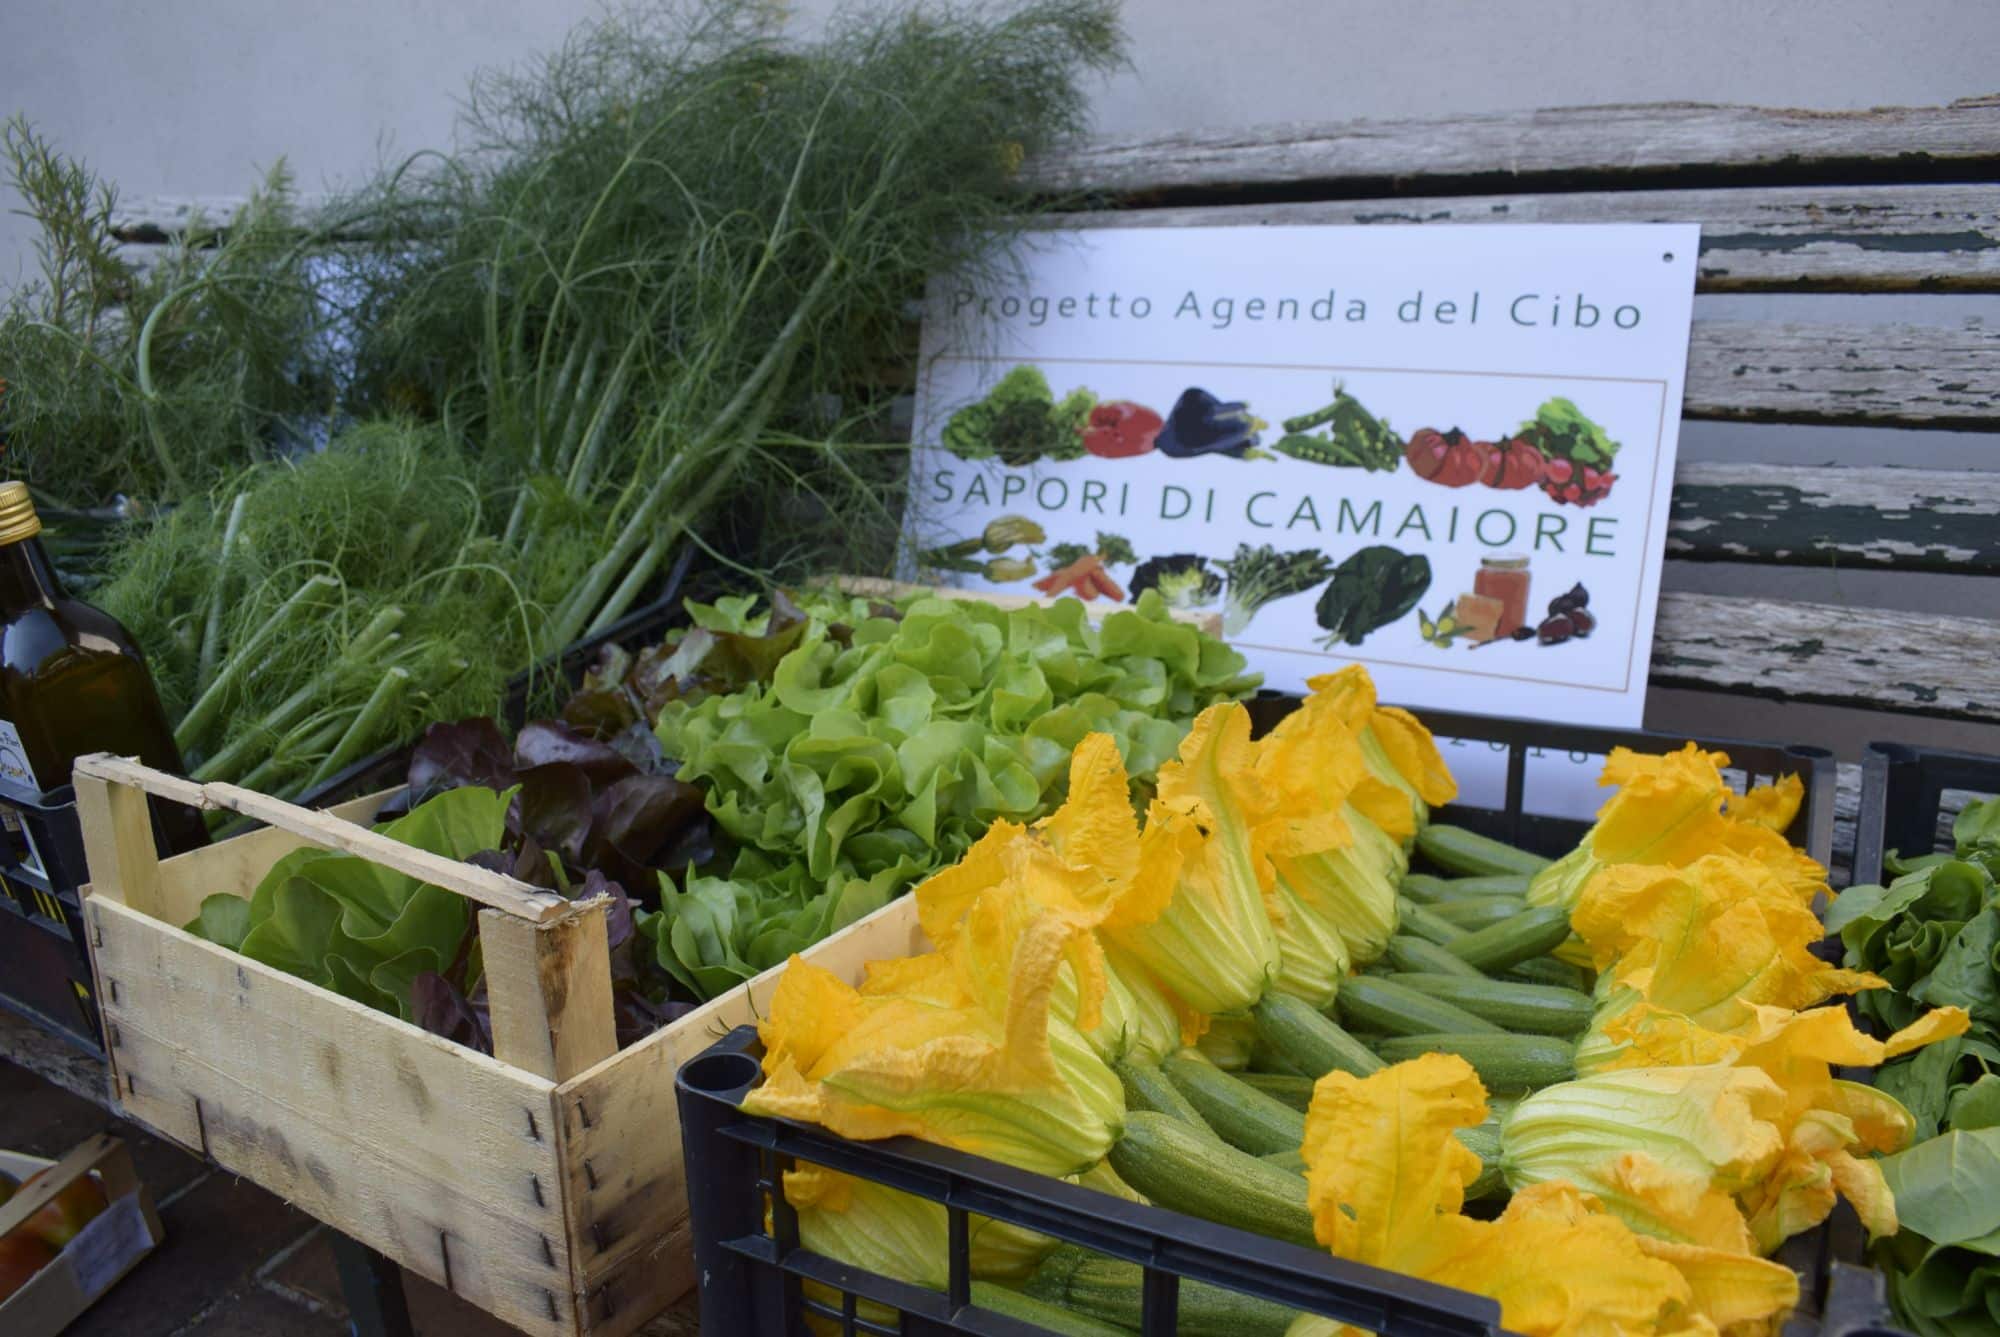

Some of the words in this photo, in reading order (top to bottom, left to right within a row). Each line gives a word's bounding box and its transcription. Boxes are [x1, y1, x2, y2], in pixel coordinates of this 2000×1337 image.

[951, 290, 1152, 327] Progetto
[1174, 289, 1366, 330] Agenda
[1397, 290, 1479, 325] del
[1510, 293, 1641, 330] Cibo
[933, 470, 1128, 516] SAPORI
[1161, 485, 1224, 523] DI
[1245, 492, 1618, 557] CAMAIORE
